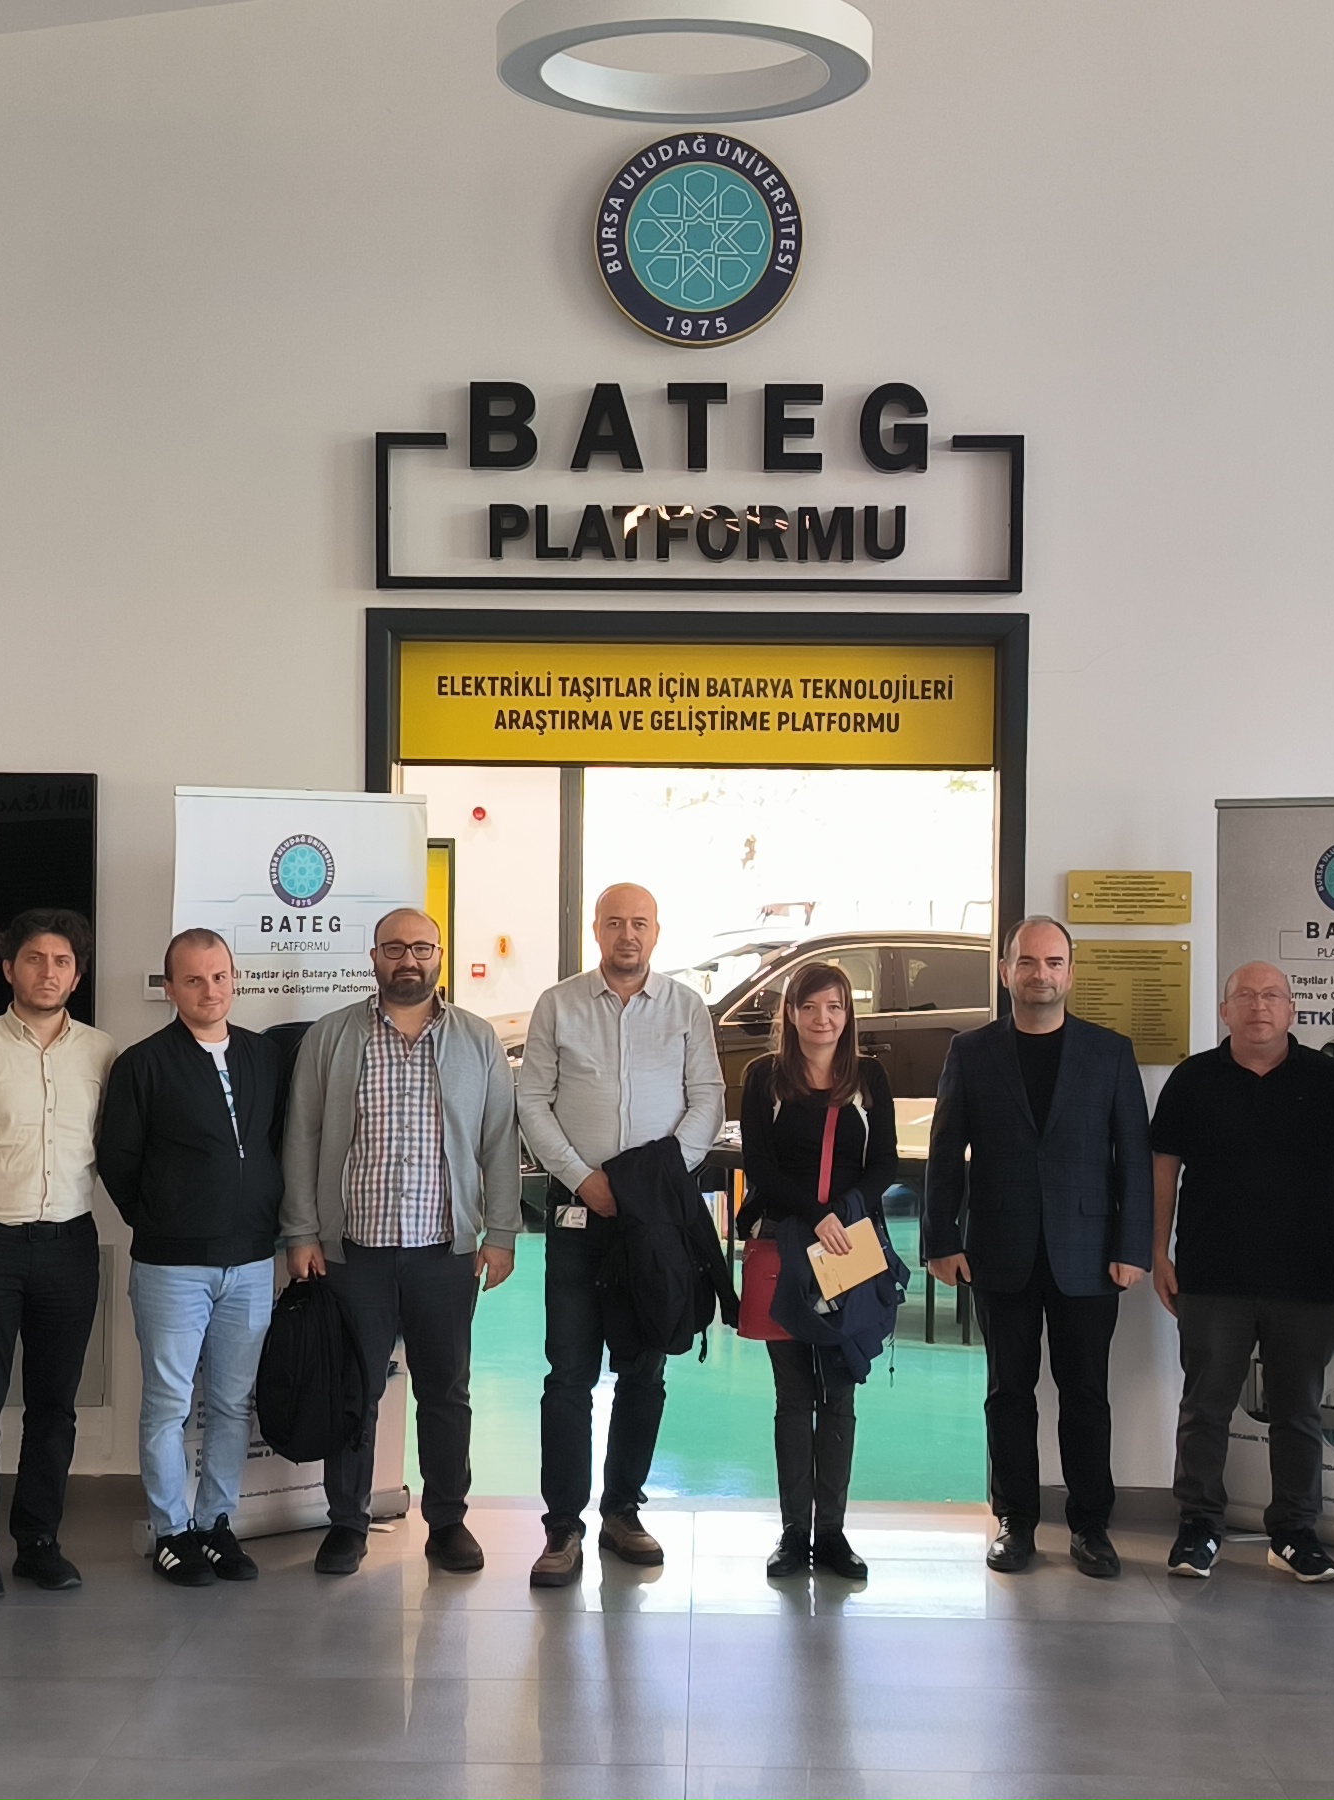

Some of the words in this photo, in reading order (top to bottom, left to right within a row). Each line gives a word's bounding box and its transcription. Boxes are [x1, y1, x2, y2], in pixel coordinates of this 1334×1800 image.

[601, 196, 625, 274] BURSA
[618, 134, 707, 190] ULUDAĞ
[716, 137, 798, 275] ÜNİVERSİTESİ
[665, 316, 728, 337] 1975
[469, 381, 929, 473] BATEG
[488, 503, 908, 562] PLATFORMU
[437, 671, 551, 697] ELEKTRİKLİ
[558, 676, 652, 703] TAŞITLAR
[658, 672, 700, 703] İÇİN
[706, 677, 794, 699] BATARYA
[800, 674, 954, 704] TEKNOLOJİLERİ
[494, 709, 613, 736] ARAŞTIRMA
[619, 710, 644, 731] VE
[650, 704, 771, 737] GELİŞTİRME
[777, 711, 900, 733] PLATFORMU
[260, 915, 341, 933] BATEG
[270, 941, 330, 952] PLATFORMU
[245, 969, 279, 981] Taşıtlar
[302, 969, 338, 981] Batarya
[341, 969, 376, 978] Teknolo
[1291, 975, 1327, 987] Taşıtlar
[232, 986, 265, 996] aştırma
[268, 986, 280, 994] ve
[282, 984, 330, 996] Geliştirme
[332, 984, 377, 993] Platformu
[1316, 993, 1328, 1001] ve
[1281, 1545, 1296, 1560] N
